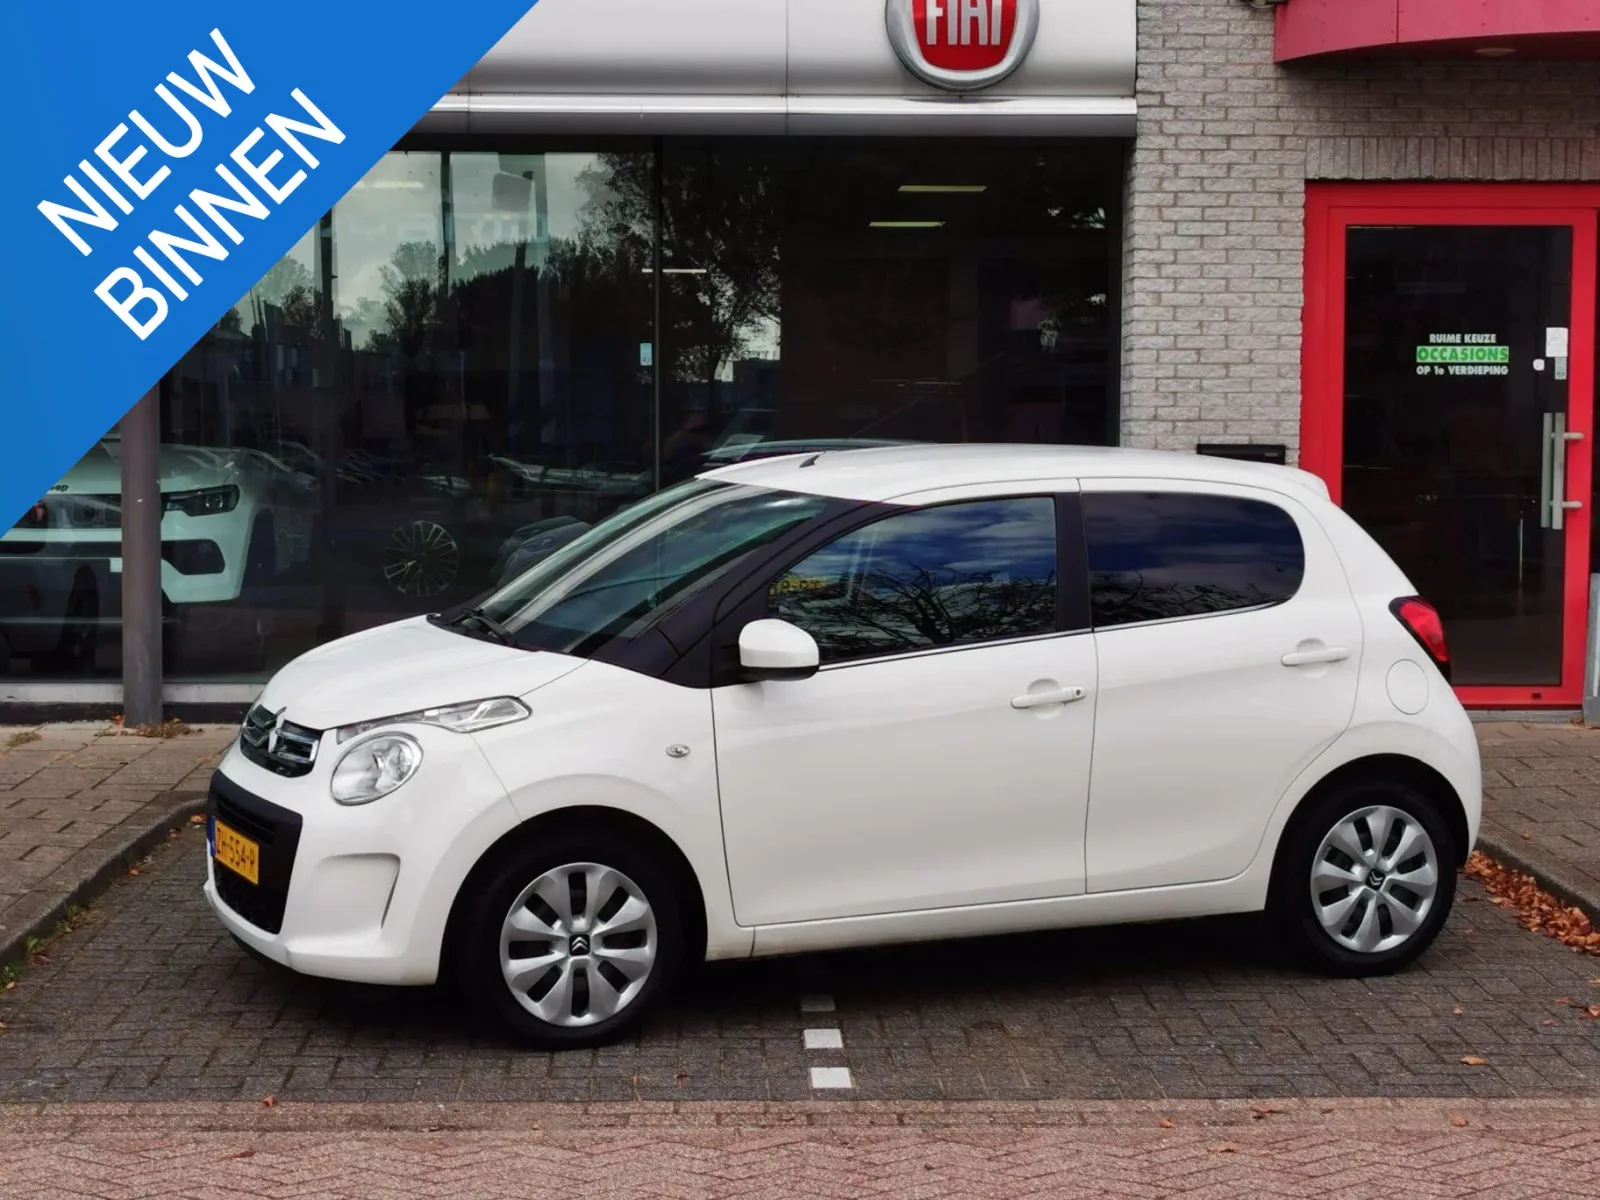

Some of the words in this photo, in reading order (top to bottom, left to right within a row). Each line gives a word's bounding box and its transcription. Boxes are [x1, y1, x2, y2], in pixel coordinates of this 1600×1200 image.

[1429, 333, 1461, 343] RUIME
[1464, 333, 1497, 343] KEUZE
[1417, 347, 1508, 361] OCCASIONS
[1416, 365, 1431, 375] OP
[1448, 365, 1509, 375] VERDIEPING
